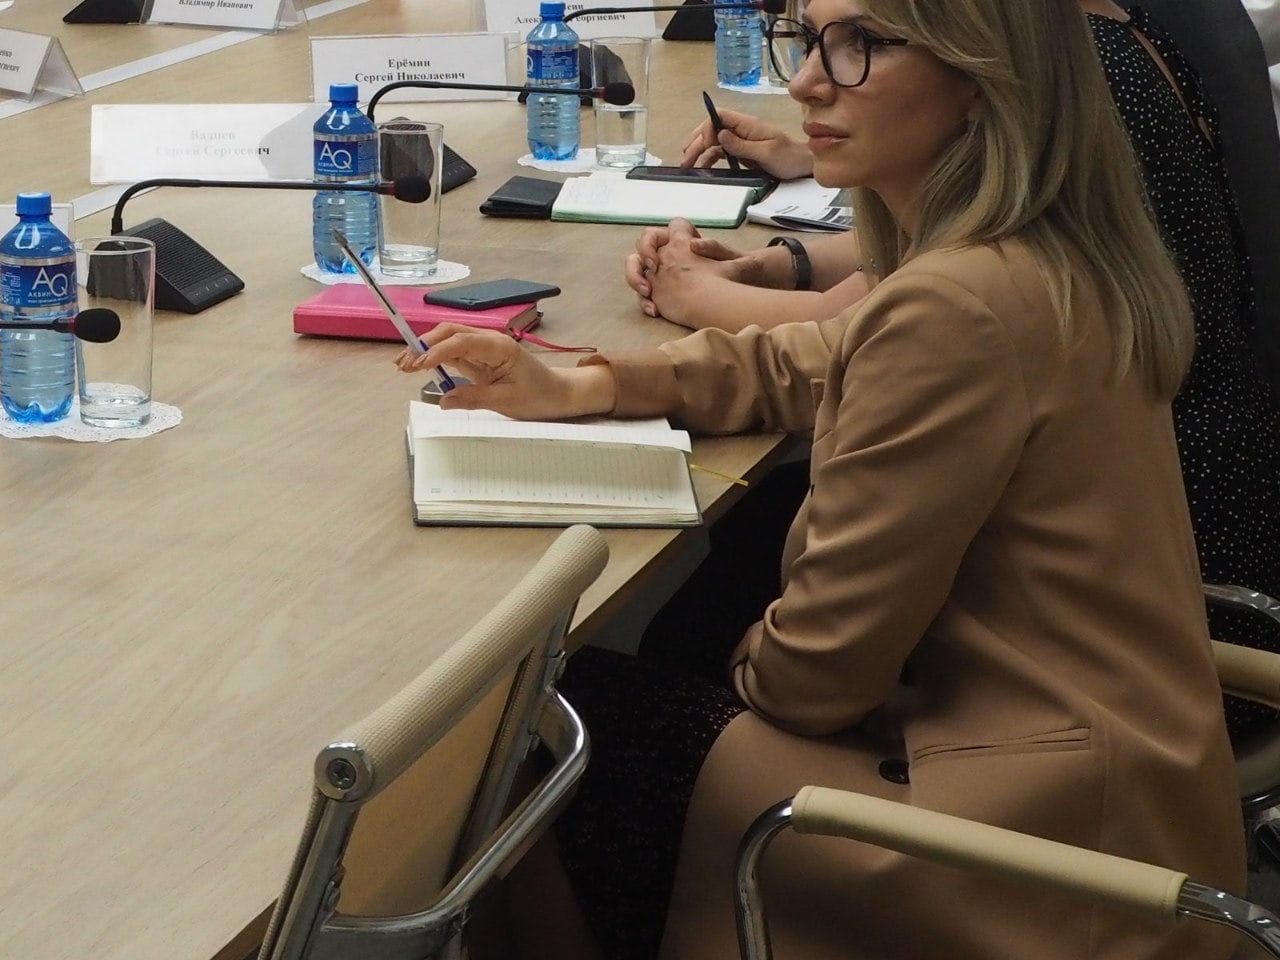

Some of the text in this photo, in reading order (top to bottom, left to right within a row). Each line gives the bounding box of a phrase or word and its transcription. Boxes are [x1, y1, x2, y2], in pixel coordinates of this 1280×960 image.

[216, 0, 253, 10] Иванович
[573, 13, 626, 26] еоргиевич
[388, 58, 431, 70] Ерёмин
[355, 71, 465, 83] Сергей Николаевич
[320, 142, 351, 169] AQ
[32, 267, 68, 296] AQ
